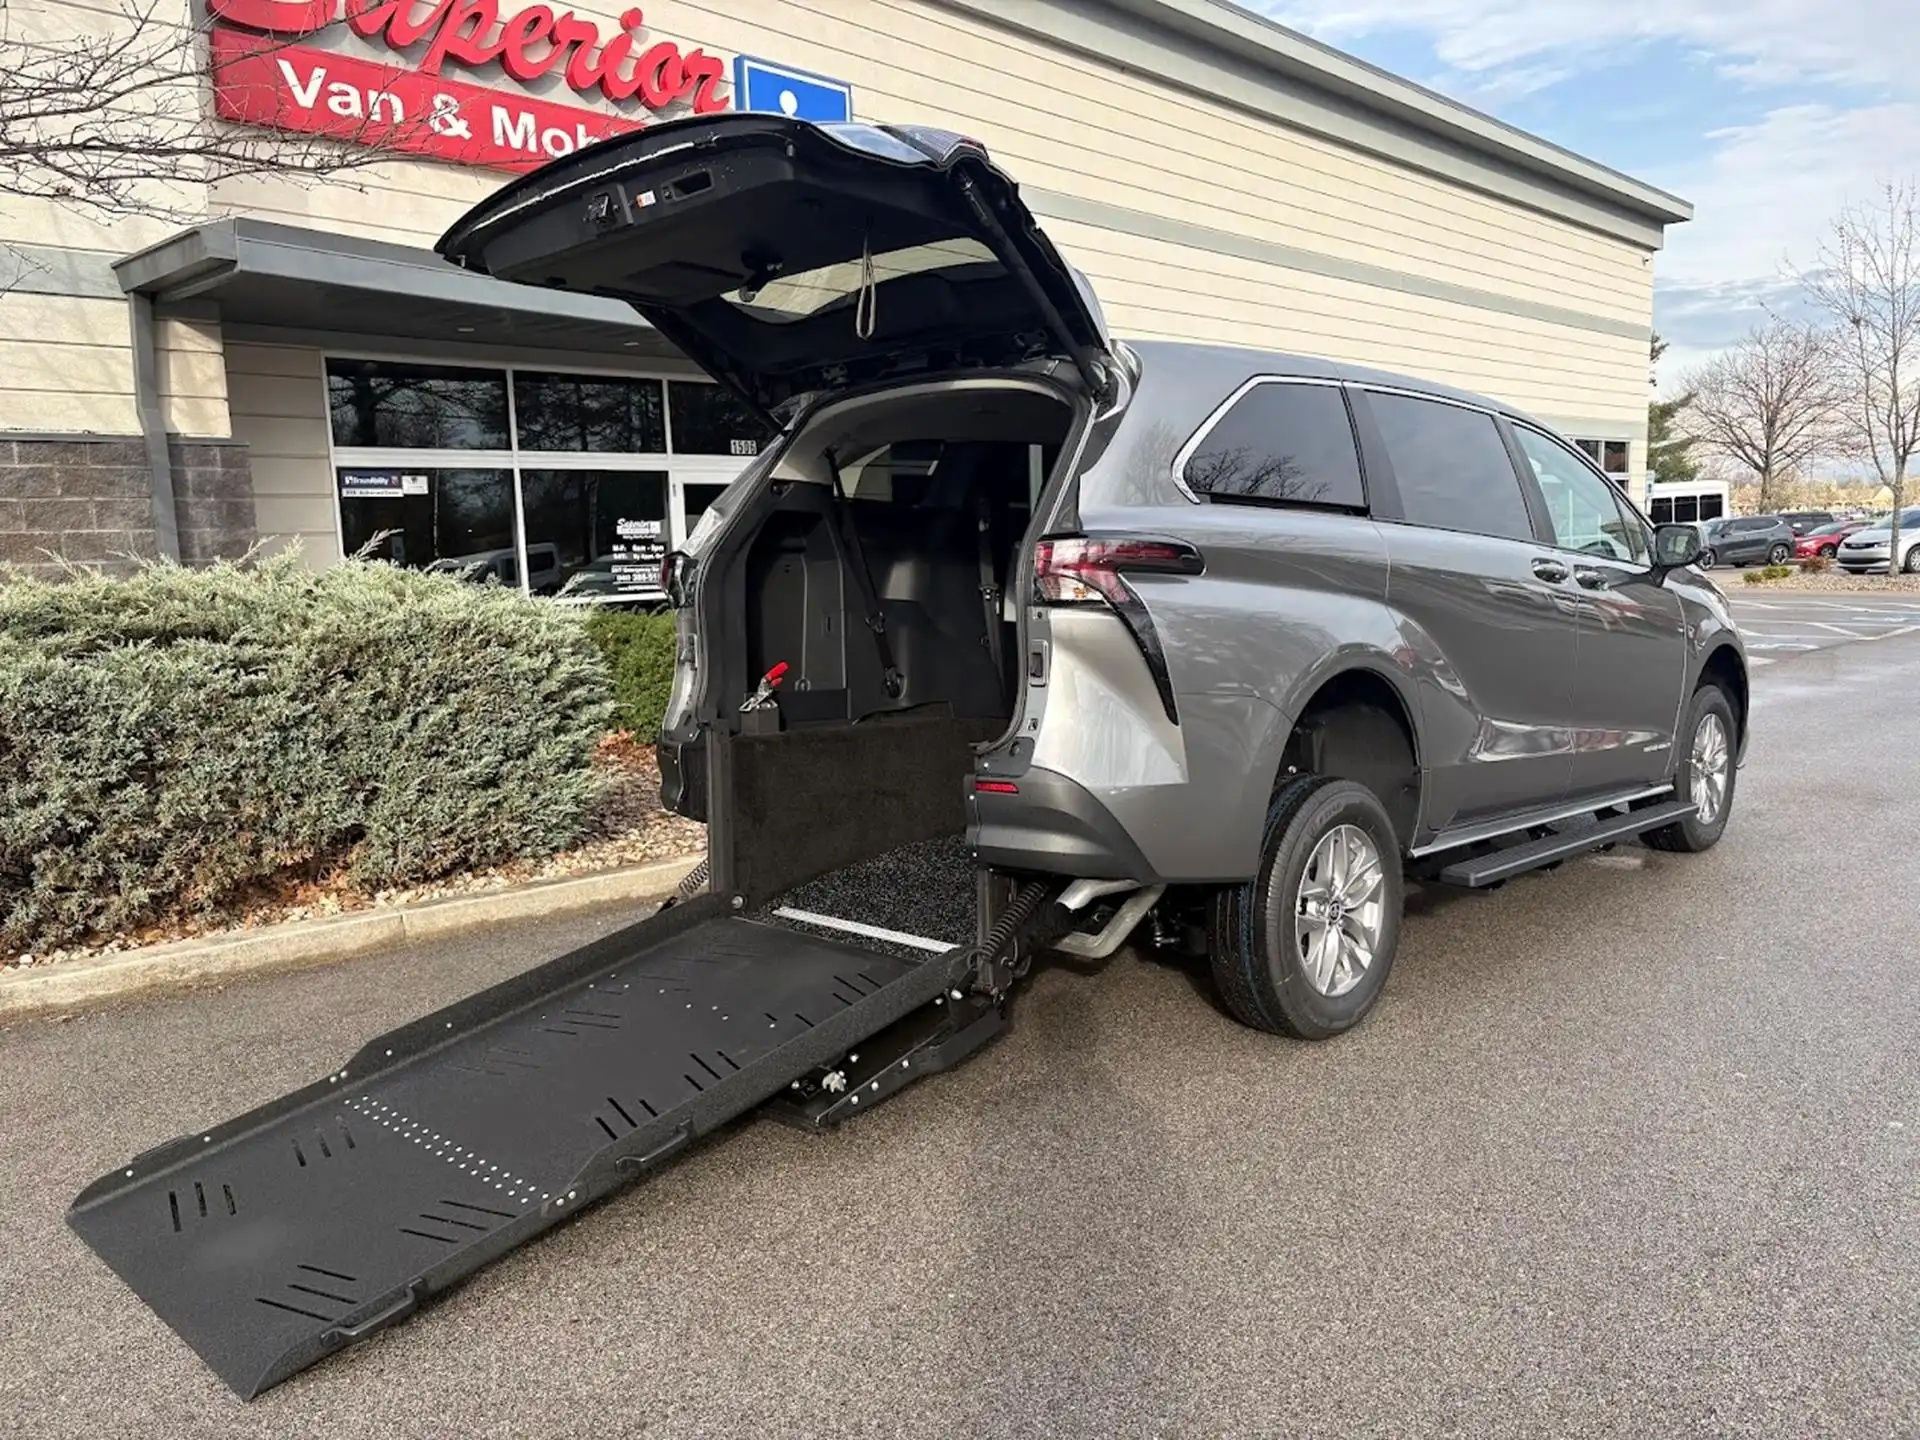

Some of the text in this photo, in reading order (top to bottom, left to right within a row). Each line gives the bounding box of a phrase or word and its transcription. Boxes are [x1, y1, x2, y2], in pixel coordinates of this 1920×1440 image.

[276, 58, 622, 159] Van & Mob
